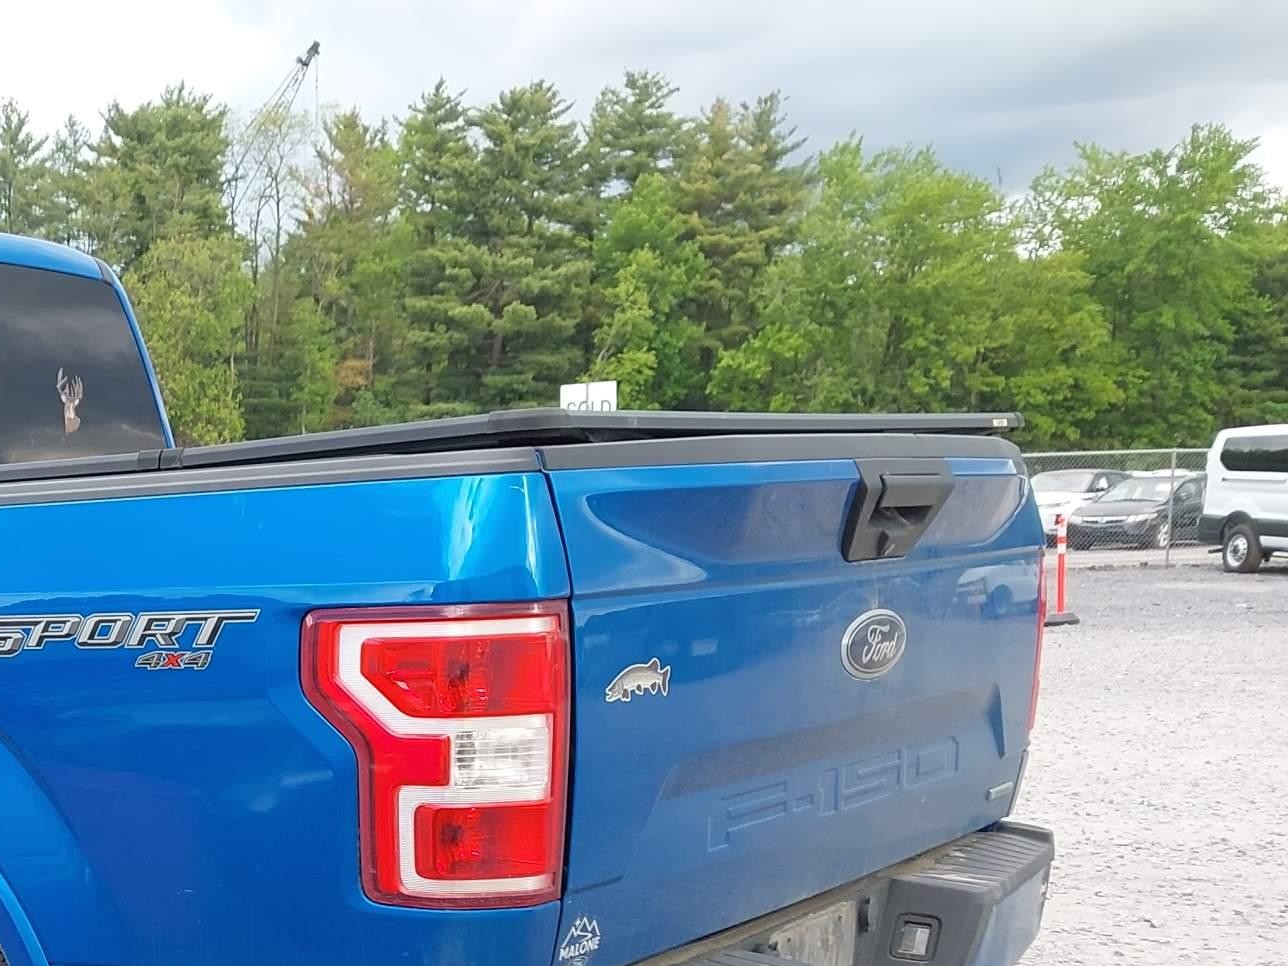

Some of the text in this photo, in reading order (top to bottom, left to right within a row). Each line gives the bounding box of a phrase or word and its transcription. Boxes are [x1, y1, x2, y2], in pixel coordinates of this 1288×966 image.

[862, 624, 899, 664] Ford
[706, 735, 960, 852] F-150
[559, 936, 601, 961] MALONE
